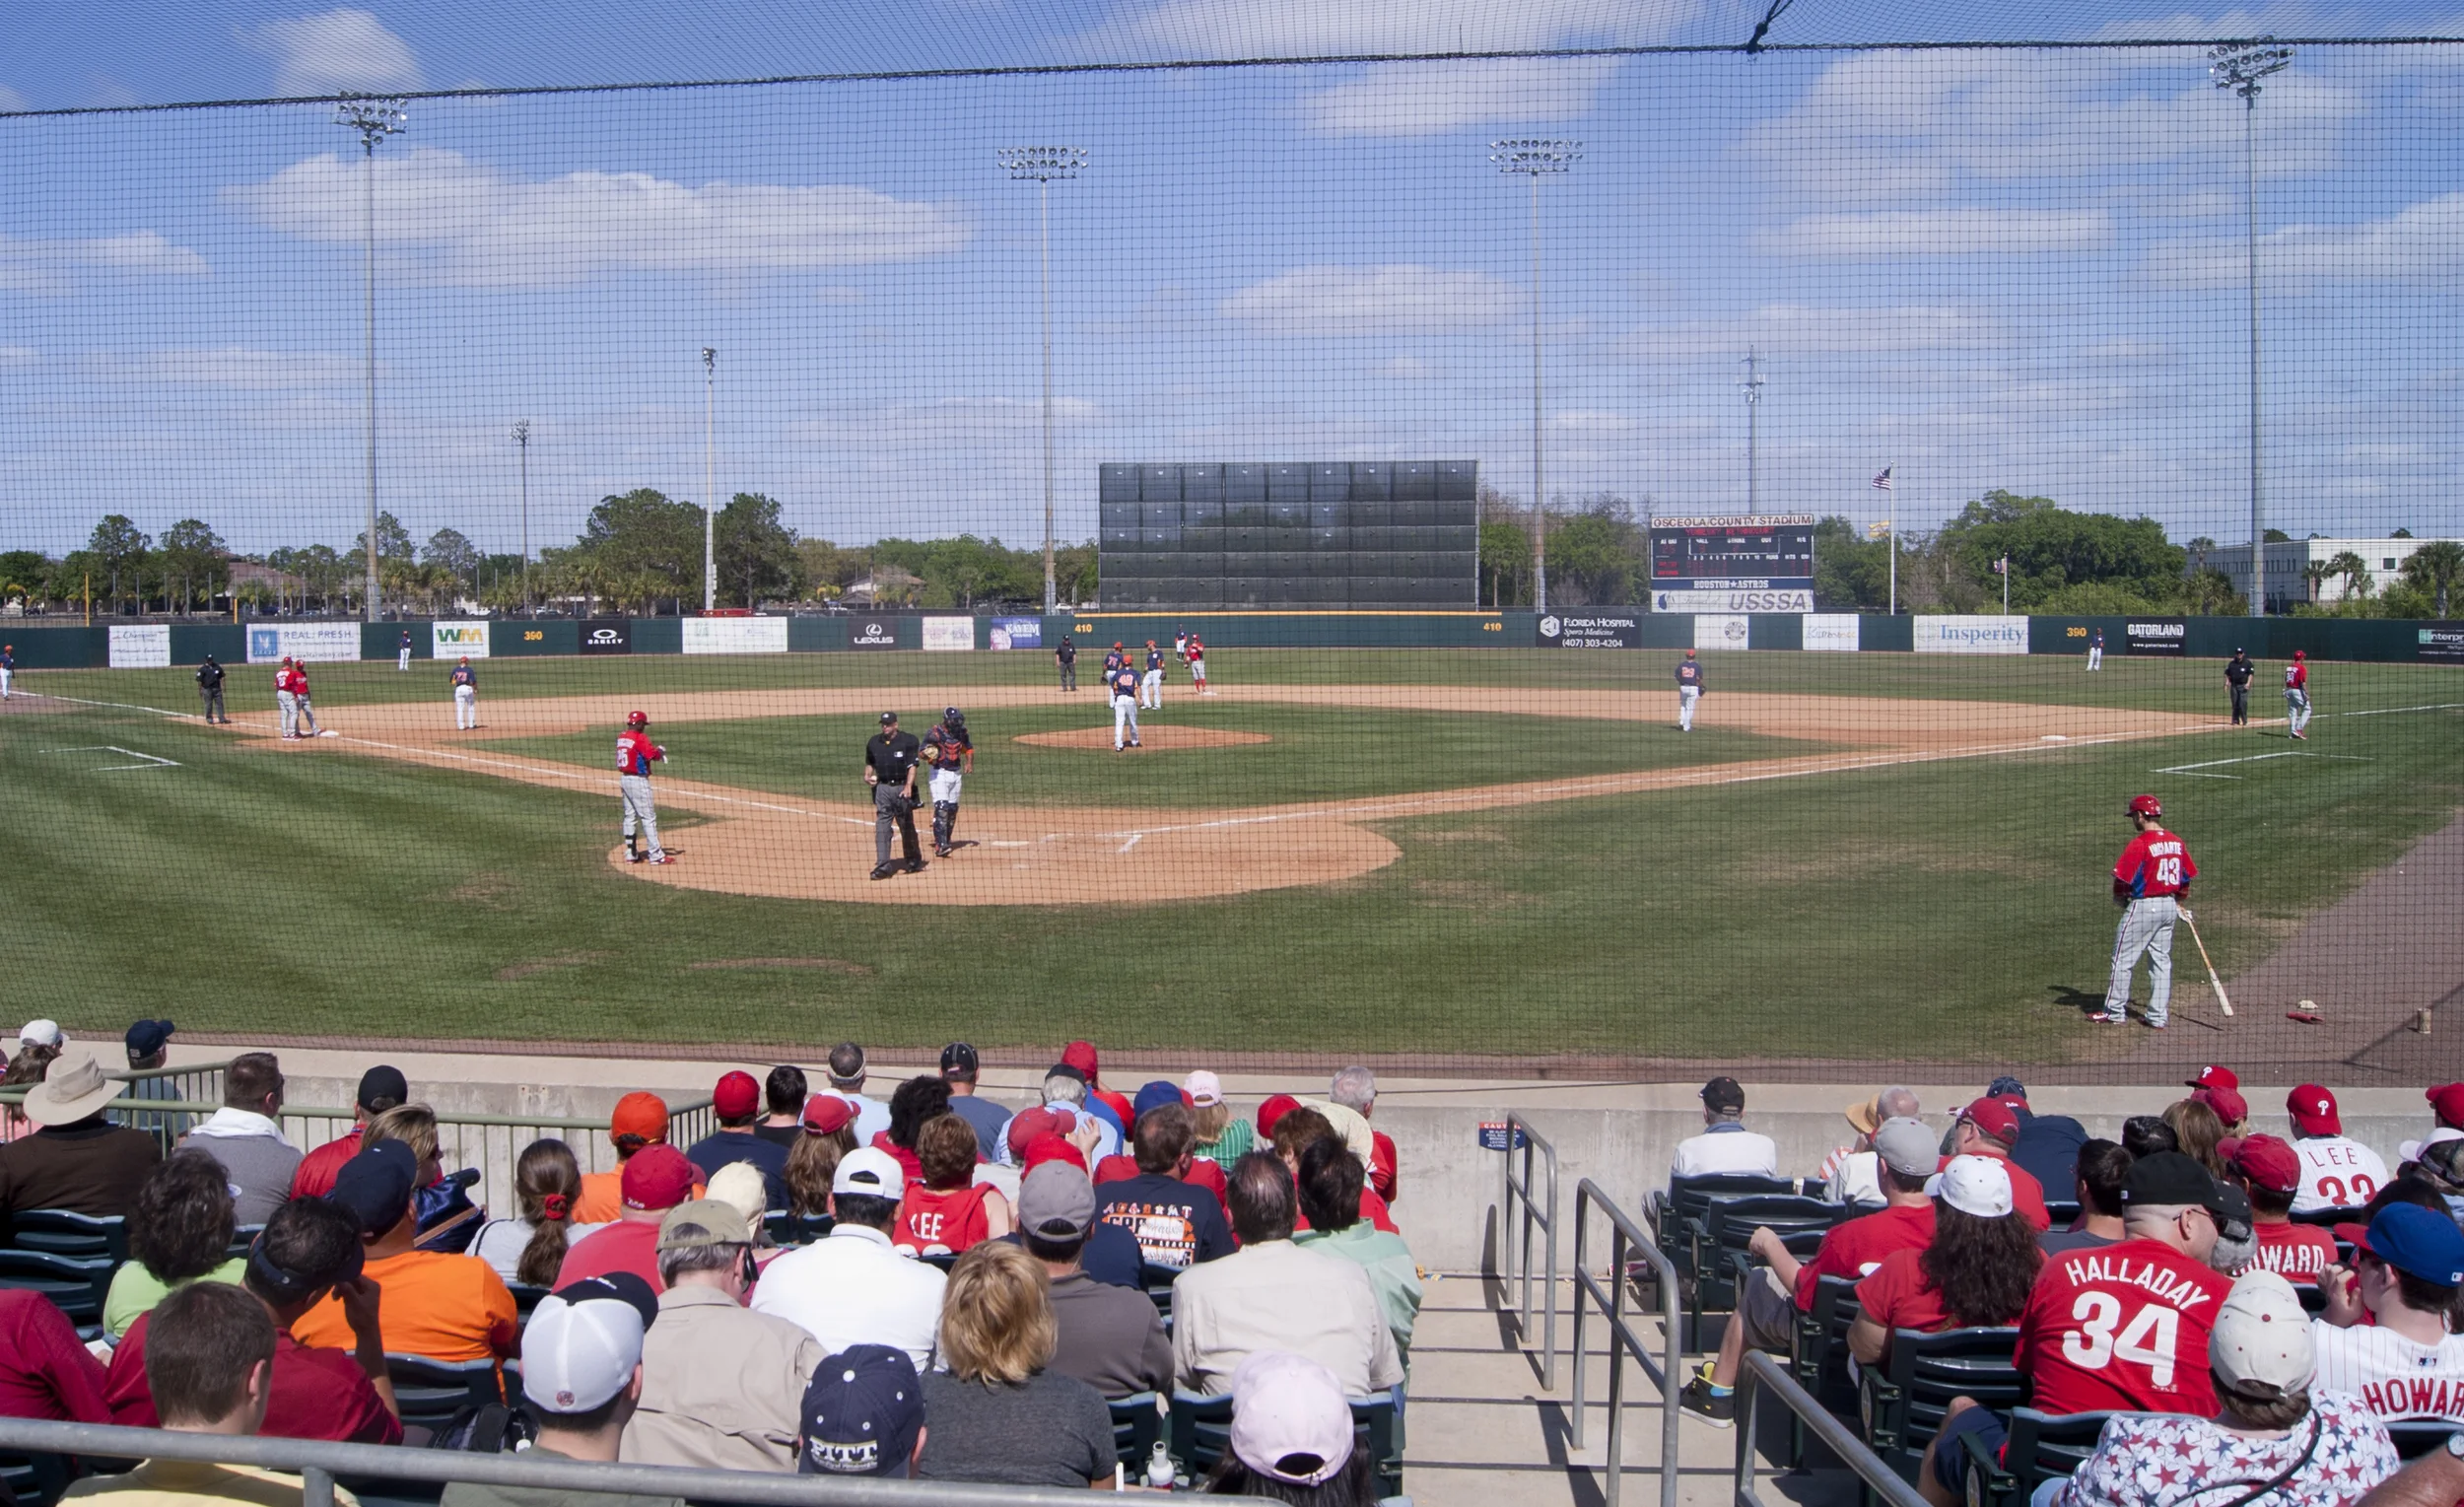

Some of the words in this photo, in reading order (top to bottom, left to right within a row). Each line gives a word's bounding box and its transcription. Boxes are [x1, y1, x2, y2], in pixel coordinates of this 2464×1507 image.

[1654, 518, 1707, 527] OSCEOLA
[1709, 516, 1755, 526] COUNTY
[1759, 515, 1812, 525] STADIUM
[1693, 580, 1730, 589] HOUSTON
[1737, 580, 1769, 588] ASTROS
[1729, 592, 1807, 611] USSSA
[1074, 623, 1093, 634] 410
[1483, 622, 1502, 632] 410
[1563, 617, 1596, 627] FLORIDA
[1597, 617, 1635, 628] HOSPITAL
[437, 628, 483, 643] WM
[523, 630, 543, 641] 390
[1005, 623, 1040, 637] KAYEM
[1941, 624, 2023, 646] Insperity
[2066, 627, 2088, 638] 390
[2127, 624, 2184, 637] GATORLAND
[854, 636, 894, 645] LEXUS
[1562, 639, 1583, 648] (407)
[1585, 639, 1623, 648] 303-4204
[2156, 857, 2180, 886] 43
[2317, 1099, 2329, 1116] P
[2307, 1147, 2358, 1167] LEE
[910, 1212, 944, 1241] LEE
[2065, 1256, 2211, 1311] HALLADAY
[2062, 1290, 2179, 1387] 34
[809, 1434, 878, 1464] PITT
